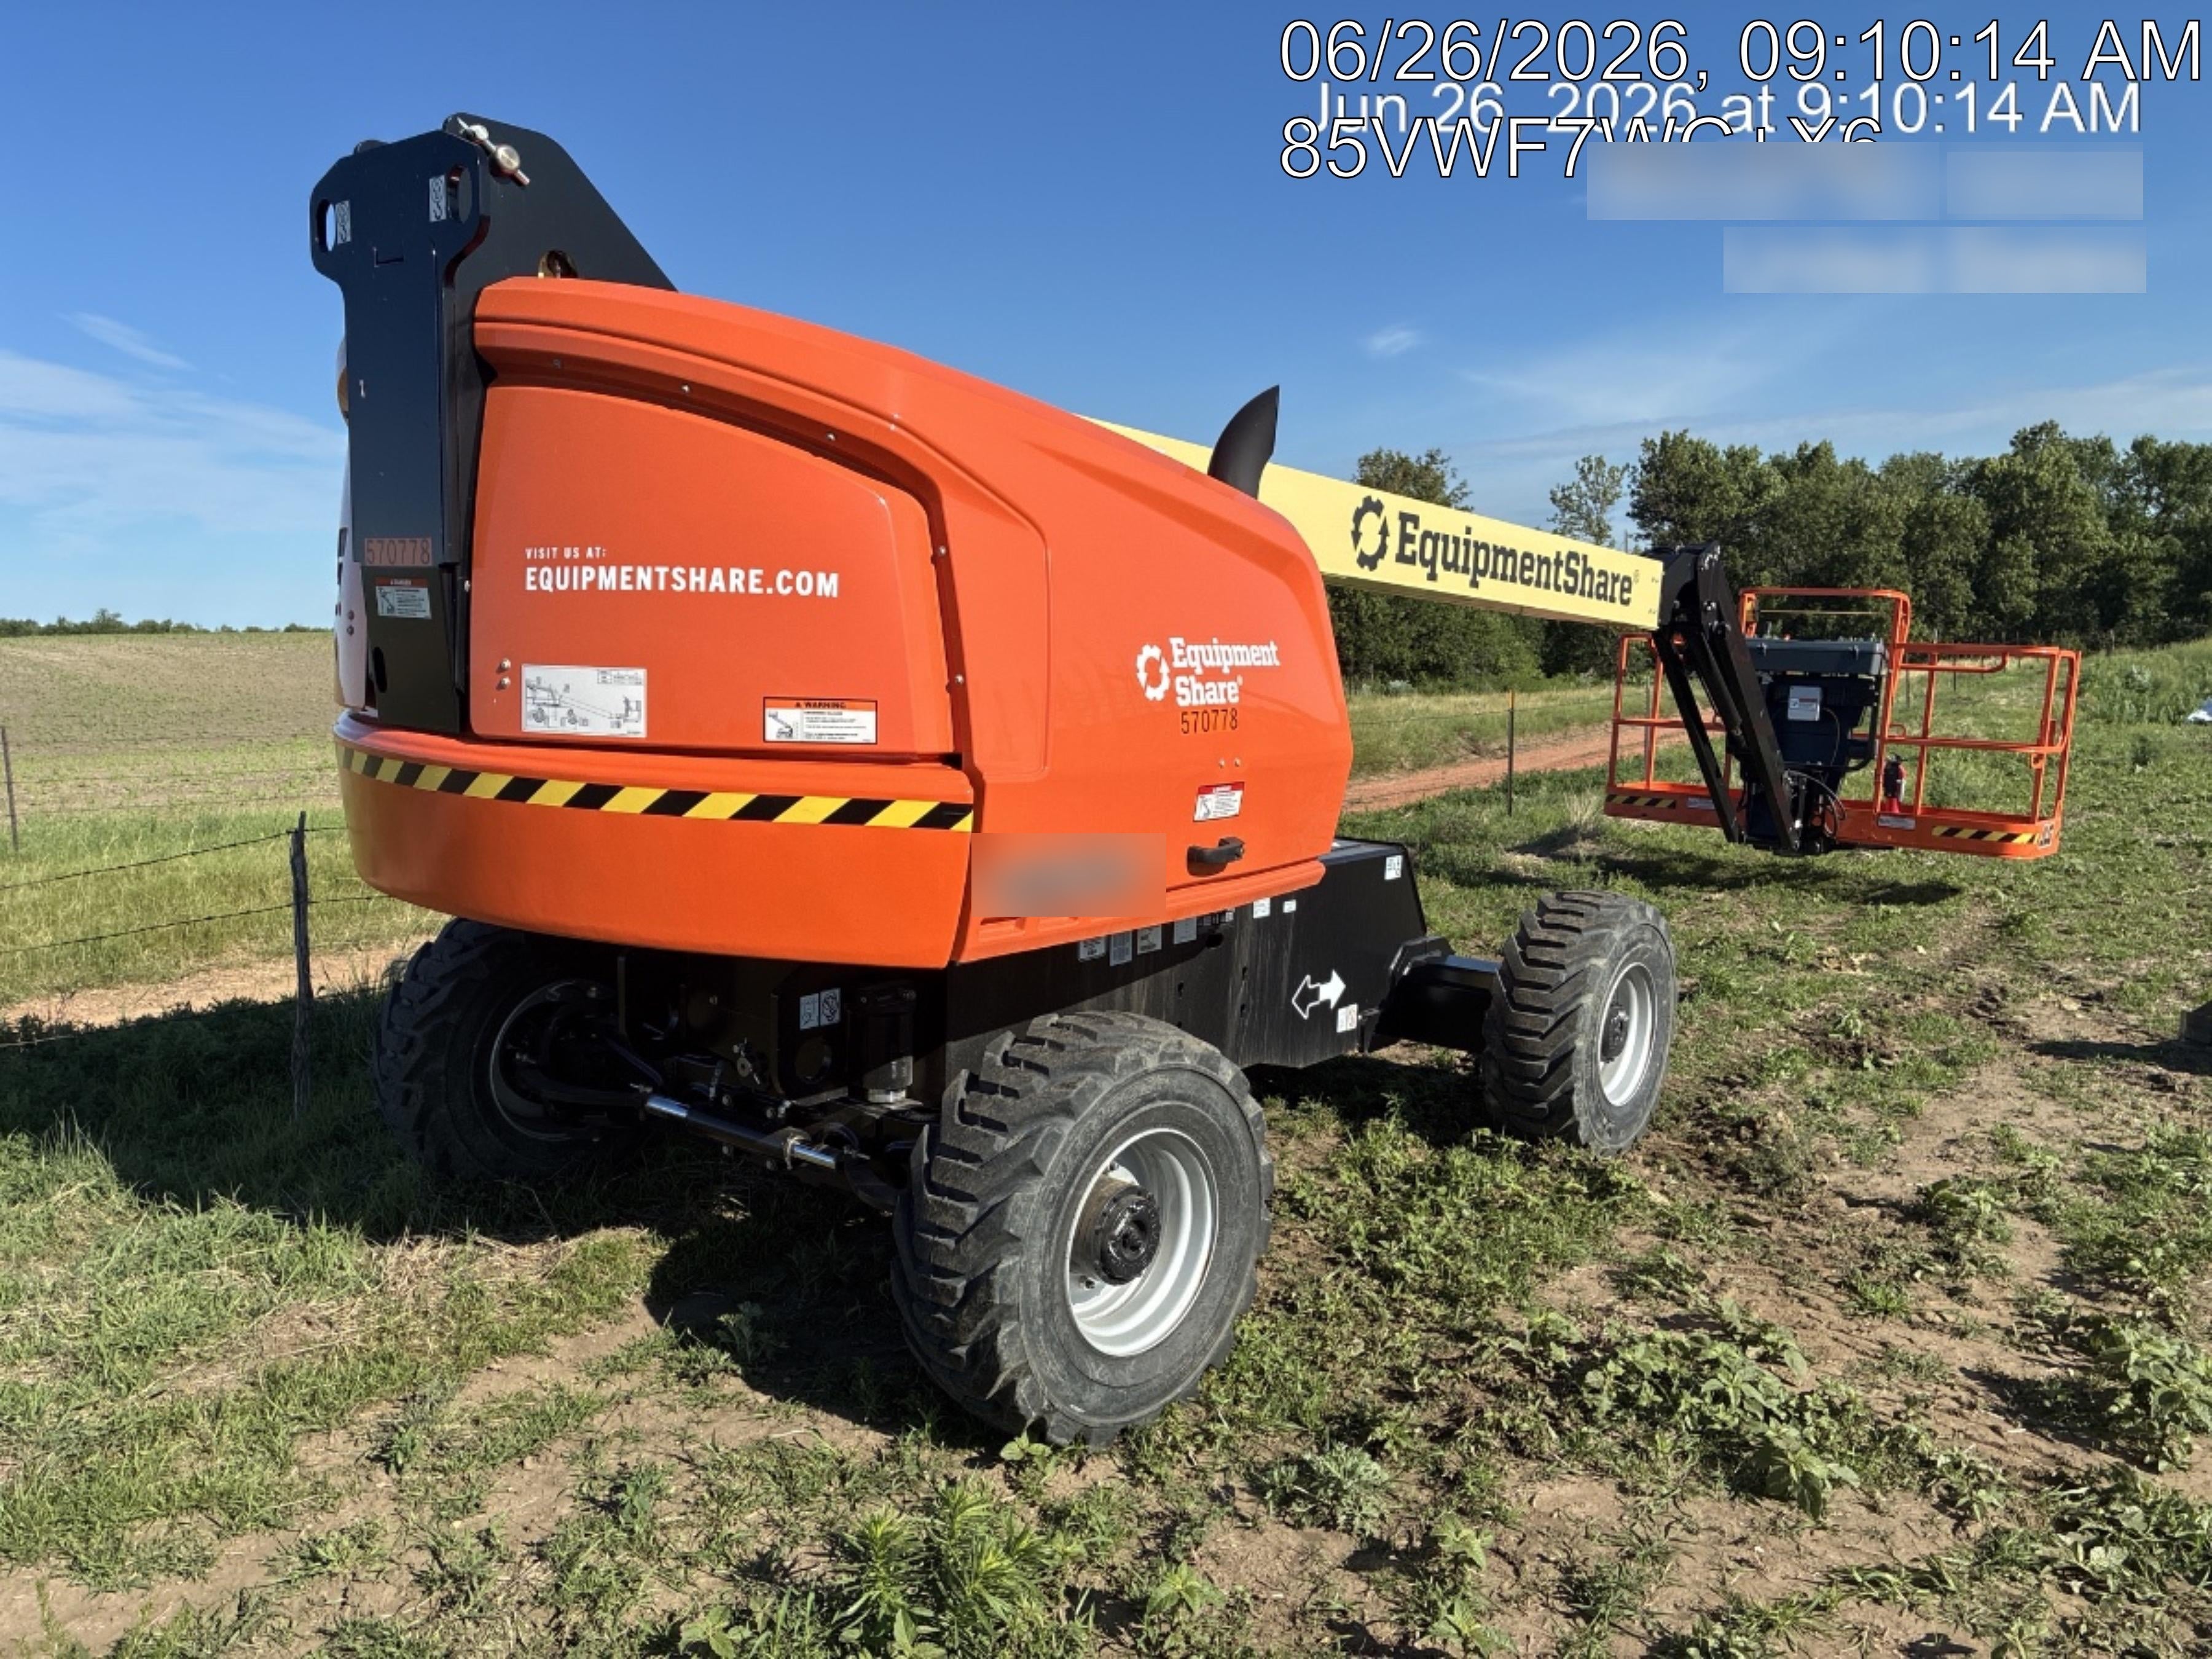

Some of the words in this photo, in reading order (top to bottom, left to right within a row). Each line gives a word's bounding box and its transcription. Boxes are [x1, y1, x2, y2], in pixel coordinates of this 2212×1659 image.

[367, 539, 430, 565] 570778
[525, 547, 559, 559] VISIT
[563, 547, 580, 559] US
[586, 547, 606, 559] AT:
[1395, 511, 1633, 606] EquipmentShare
[525, 565, 839, 598] EQUIPMENTSHARE.COM
[1169, 637, 1281, 675] Equipment
[1175, 675, 1240, 707] Share
[1181, 707, 1237, 734] 570778
